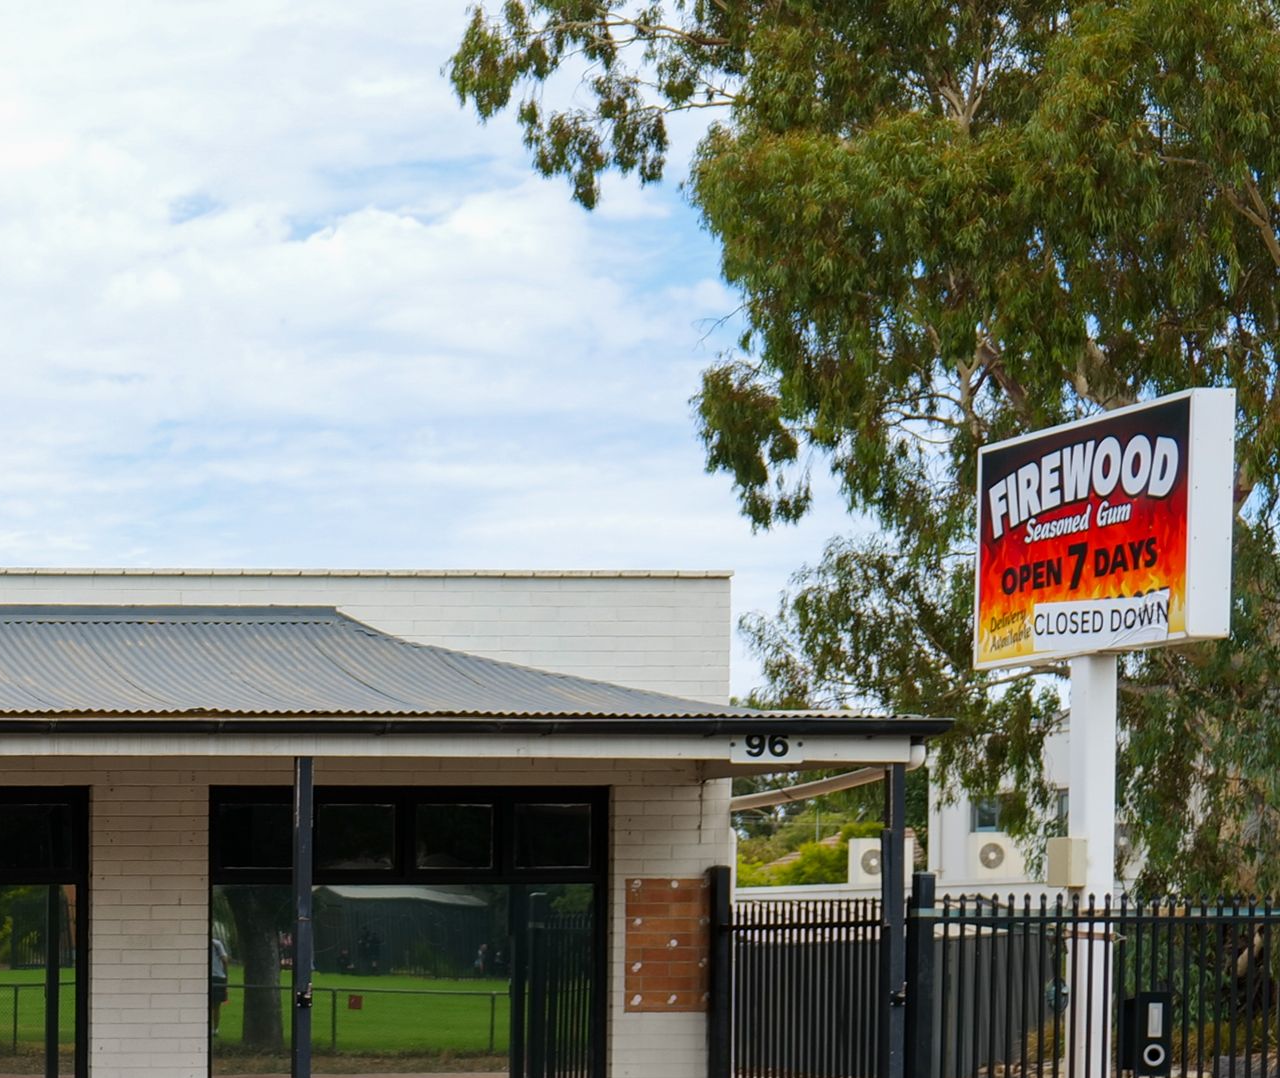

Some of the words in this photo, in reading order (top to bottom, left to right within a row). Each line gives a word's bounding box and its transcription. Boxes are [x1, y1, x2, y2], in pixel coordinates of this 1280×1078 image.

[989, 434, 1179, 540] FIREWOOD
[1024, 504, 1091, 544] Seasoned
[1096, 500, 1132, 527] Gum
[1001, 556, 1062, 595] OPEN
[1068, 542, 1089, 590] 7
[1094, 537, 1158, 578] DAYS
[991, 608, 1027, 633] Delivery
[1034, 610, 1104, 636] CLOSED
[1111, 599, 1169, 632] DOWN
[991, 625, 1032, 652] Available
[745, 734, 789, 758] 96
